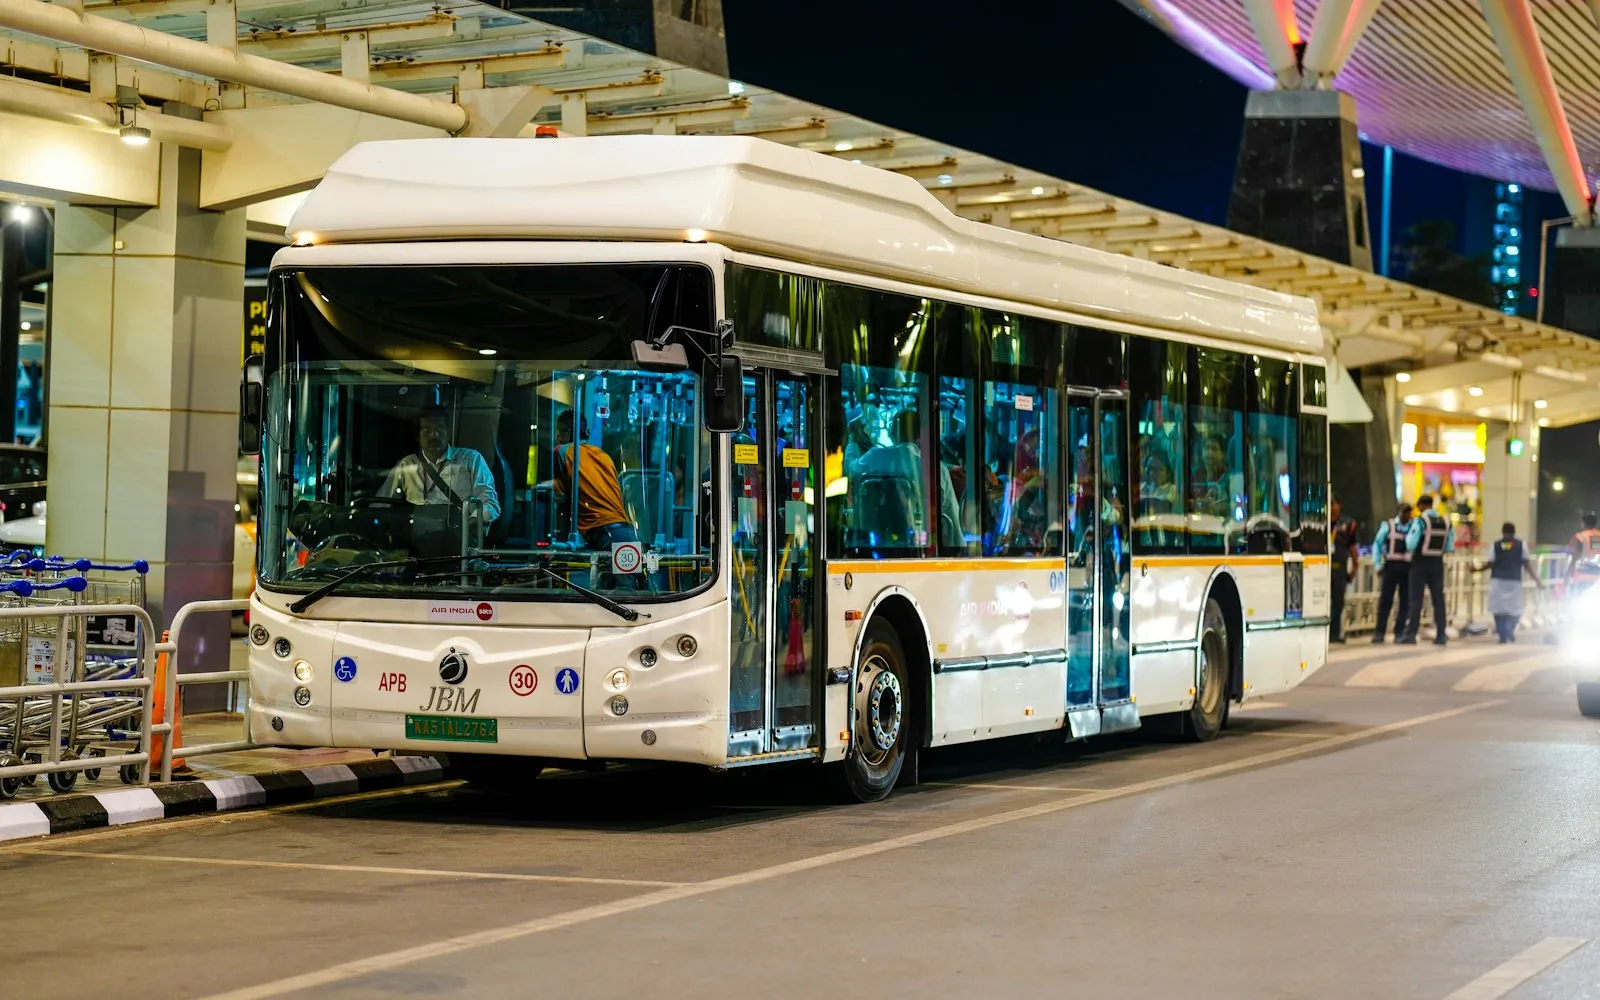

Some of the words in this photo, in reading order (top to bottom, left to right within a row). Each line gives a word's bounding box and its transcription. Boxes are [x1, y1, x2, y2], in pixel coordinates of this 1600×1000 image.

[621, 552, 634, 563] 30
[378, 672, 406, 692] APB
[514, 672, 534, 689] 30
[419, 686, 481, 713] JBM
